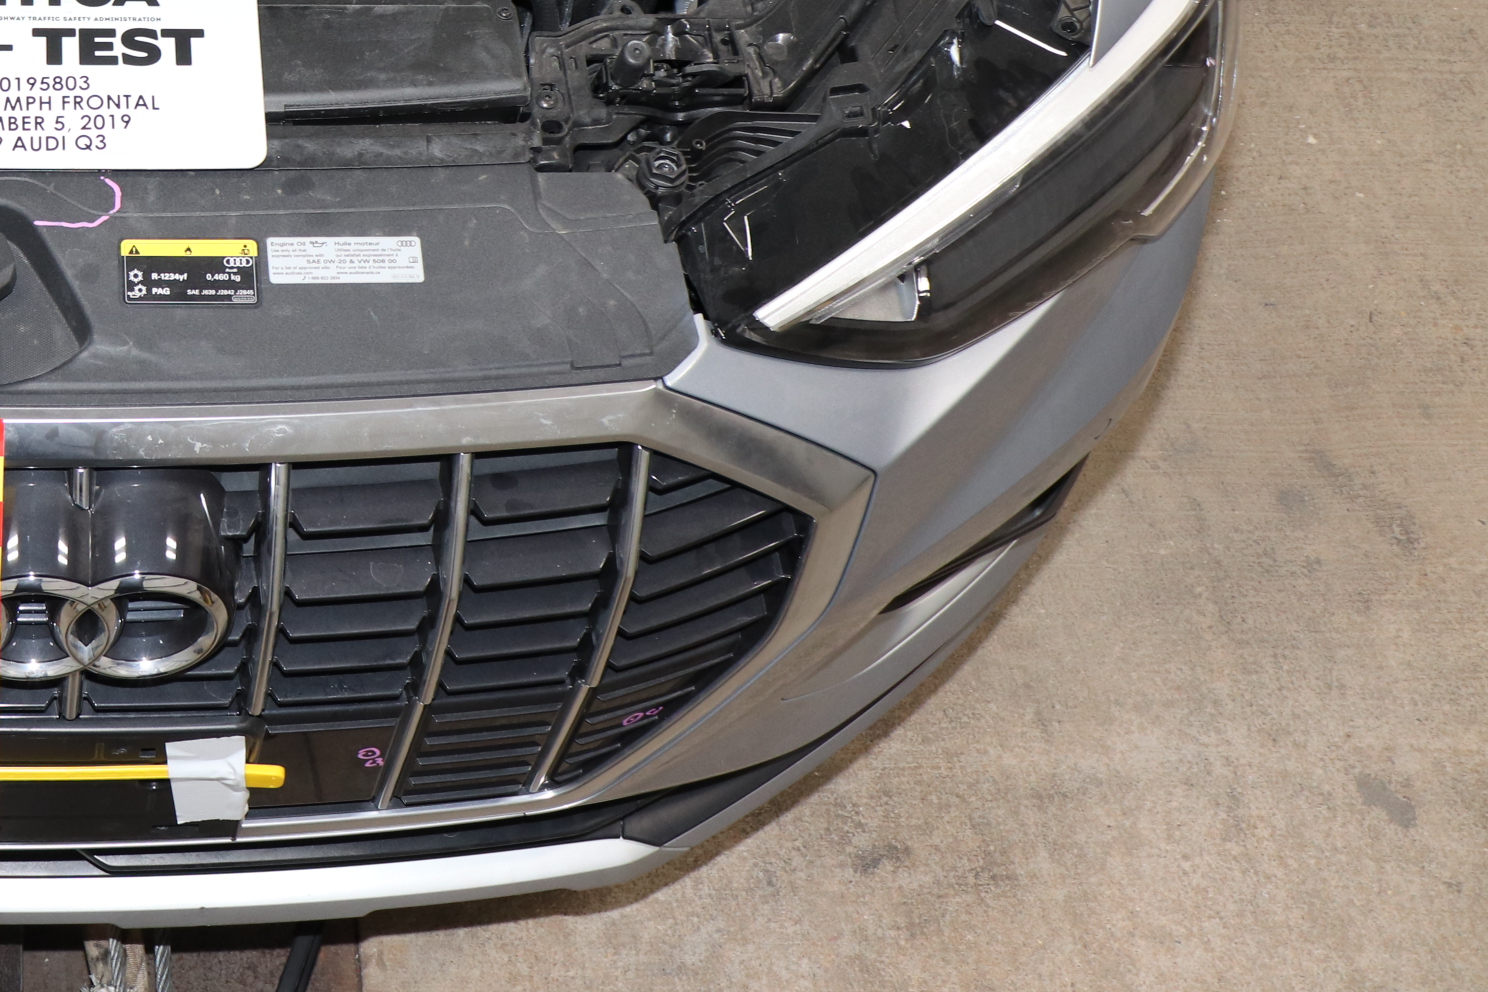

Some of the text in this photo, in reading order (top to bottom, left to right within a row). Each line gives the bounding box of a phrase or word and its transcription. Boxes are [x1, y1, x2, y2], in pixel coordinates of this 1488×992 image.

[32, 27, 205, 66] TEST
[4, 96, 52, 111] MPH
[62, 94, 160, 111] FRONTAL
[54, 116, 71, 133] 5,
[80, 114, 132, 130] 2019
[12, 135, 65, 151] AUDI
[75, 134, 107, 152] Q3
[151, 272, 188, 282] R-1234yf
[206, 273, 241, 282] 0,460 kg
[152, 287, 171, 295] PAG
